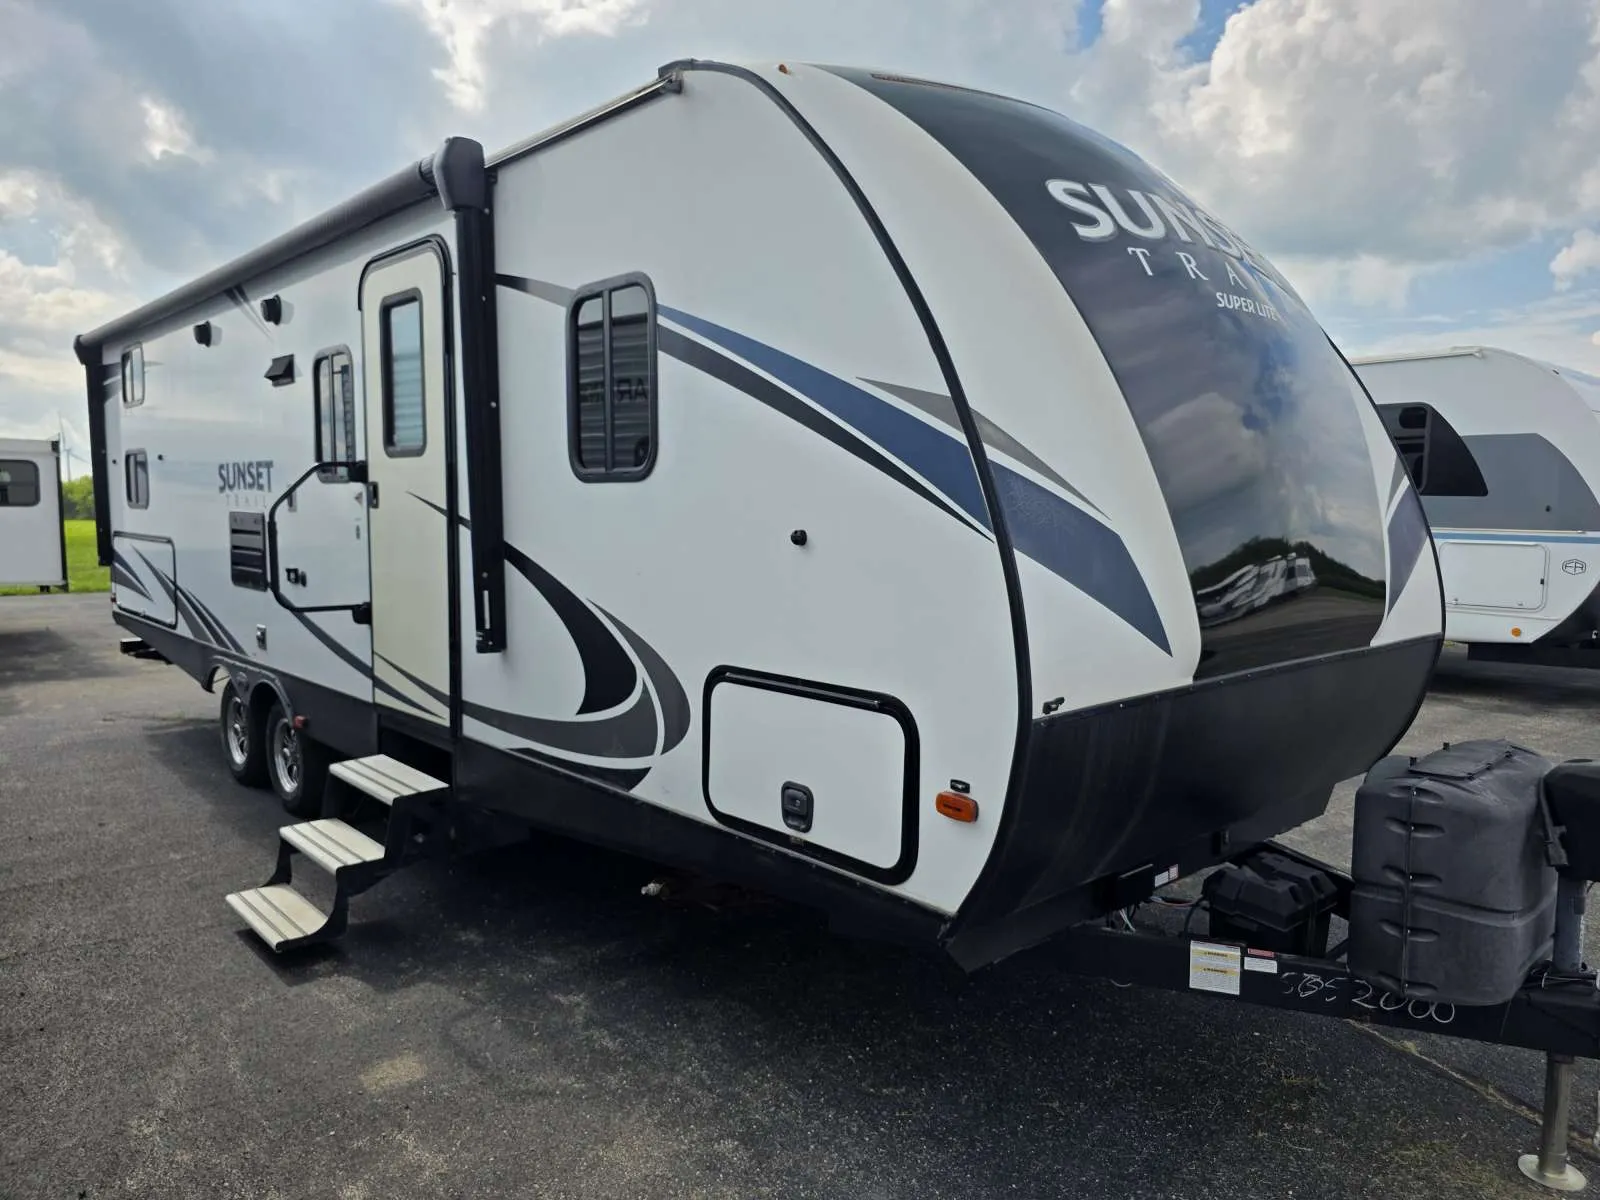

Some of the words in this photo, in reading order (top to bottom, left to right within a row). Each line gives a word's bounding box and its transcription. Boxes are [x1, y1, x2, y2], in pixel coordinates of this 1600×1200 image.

[1216, 292, 1255, 313] SUPER
[1256, 302, 1278, 321] LITE
[218, 460, 274, 493] SUNSET
